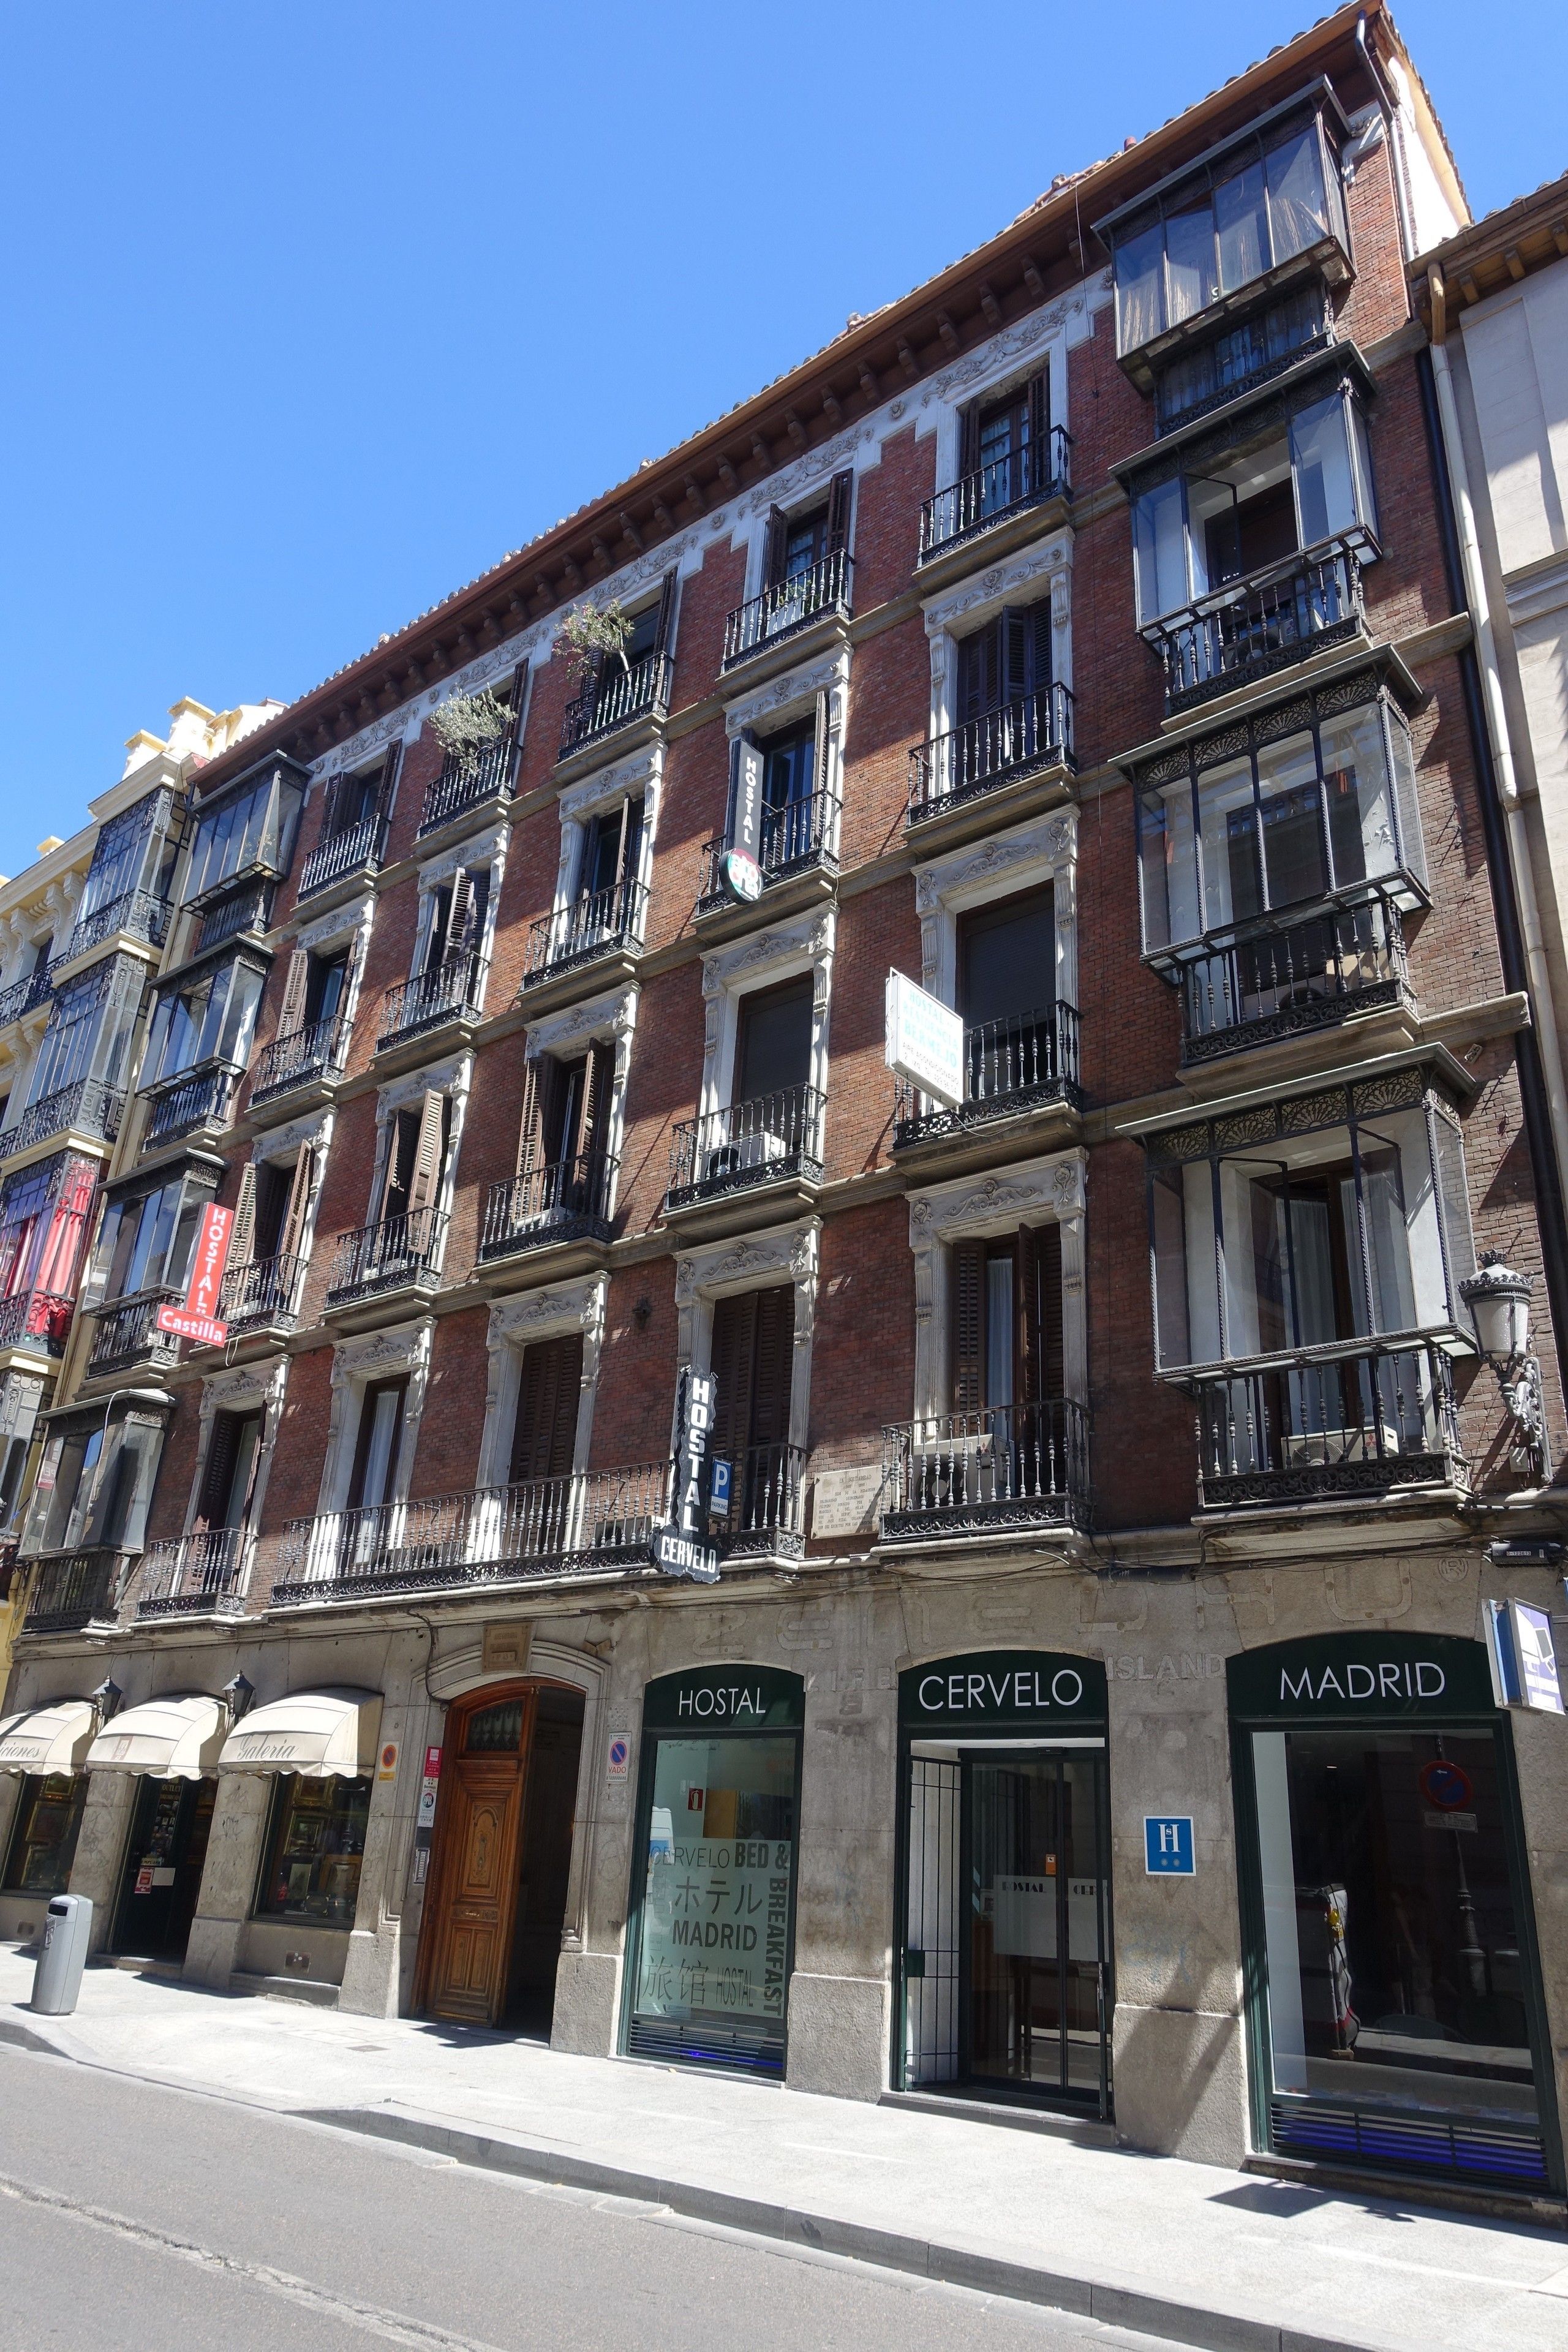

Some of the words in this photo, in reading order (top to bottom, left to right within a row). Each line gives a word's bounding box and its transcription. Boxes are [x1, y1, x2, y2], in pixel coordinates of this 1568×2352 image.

[742, 756, 756, 845] HOSTAL
[909, 990, 944, 1024] HOSTAL
[198, 1208, 226, 1308] HOSTAL
[161, 1311, 222, 1343] Castilla
[683, 1378, 710, 1532] HOSTAL
[714, 1464, 728, 1495] P
[711, 1501, 728, 1510] PARKING
[661, 1536, 716, 1574] CERVELO
[919, 1670, 1083, 1710] CERVELO
[1280, 1662, 1446, 1700] MADRID
[679, 1687, 766, 1716] HOSTAL
[237, 1735, 299, 1760] Galeria
[649, 1845, 730, 1869] CERVELO
[734, 1842, 769, 1868] BED
[775, 1844, 790, 1870] &
[674, 1876, 763, 1915] ホテル
[672, 1920, 758, 1951] MADRID
[763, 1877, 788, 2016] BREAKFAST
[642, 1954, 709, 2005] 旅馆
[715, 1967, 754, 2007] HOSTAL
